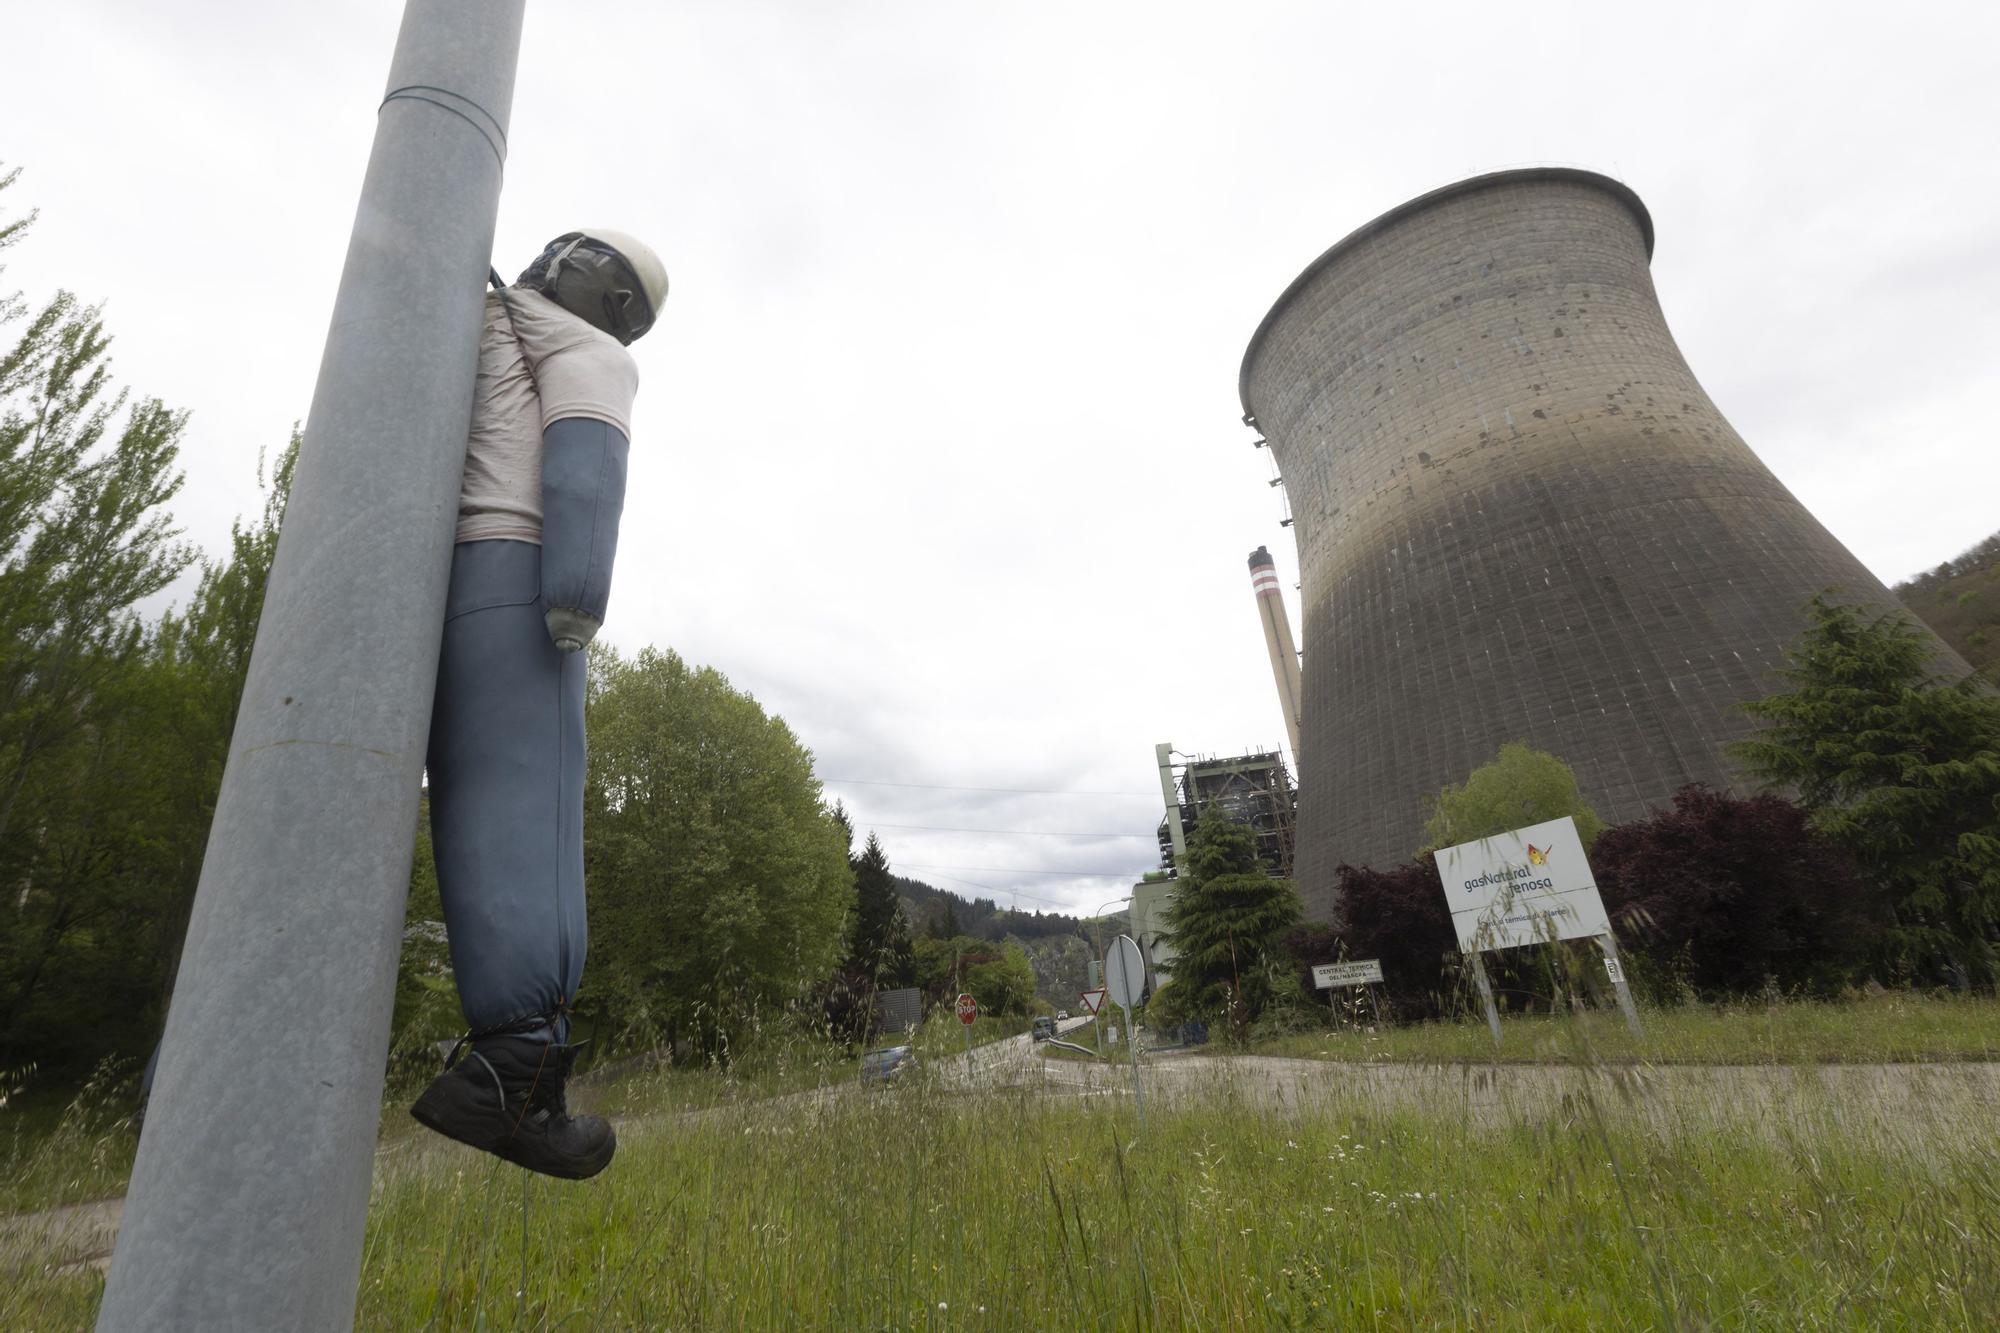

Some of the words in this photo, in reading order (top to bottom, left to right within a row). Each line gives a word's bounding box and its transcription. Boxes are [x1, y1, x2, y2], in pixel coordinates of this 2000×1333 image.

[1509, 877, 1553, 898] fenosa
[1319, 967, 1346, 975] CENTRAL
[958, 1005, 976, 1014] STOP
